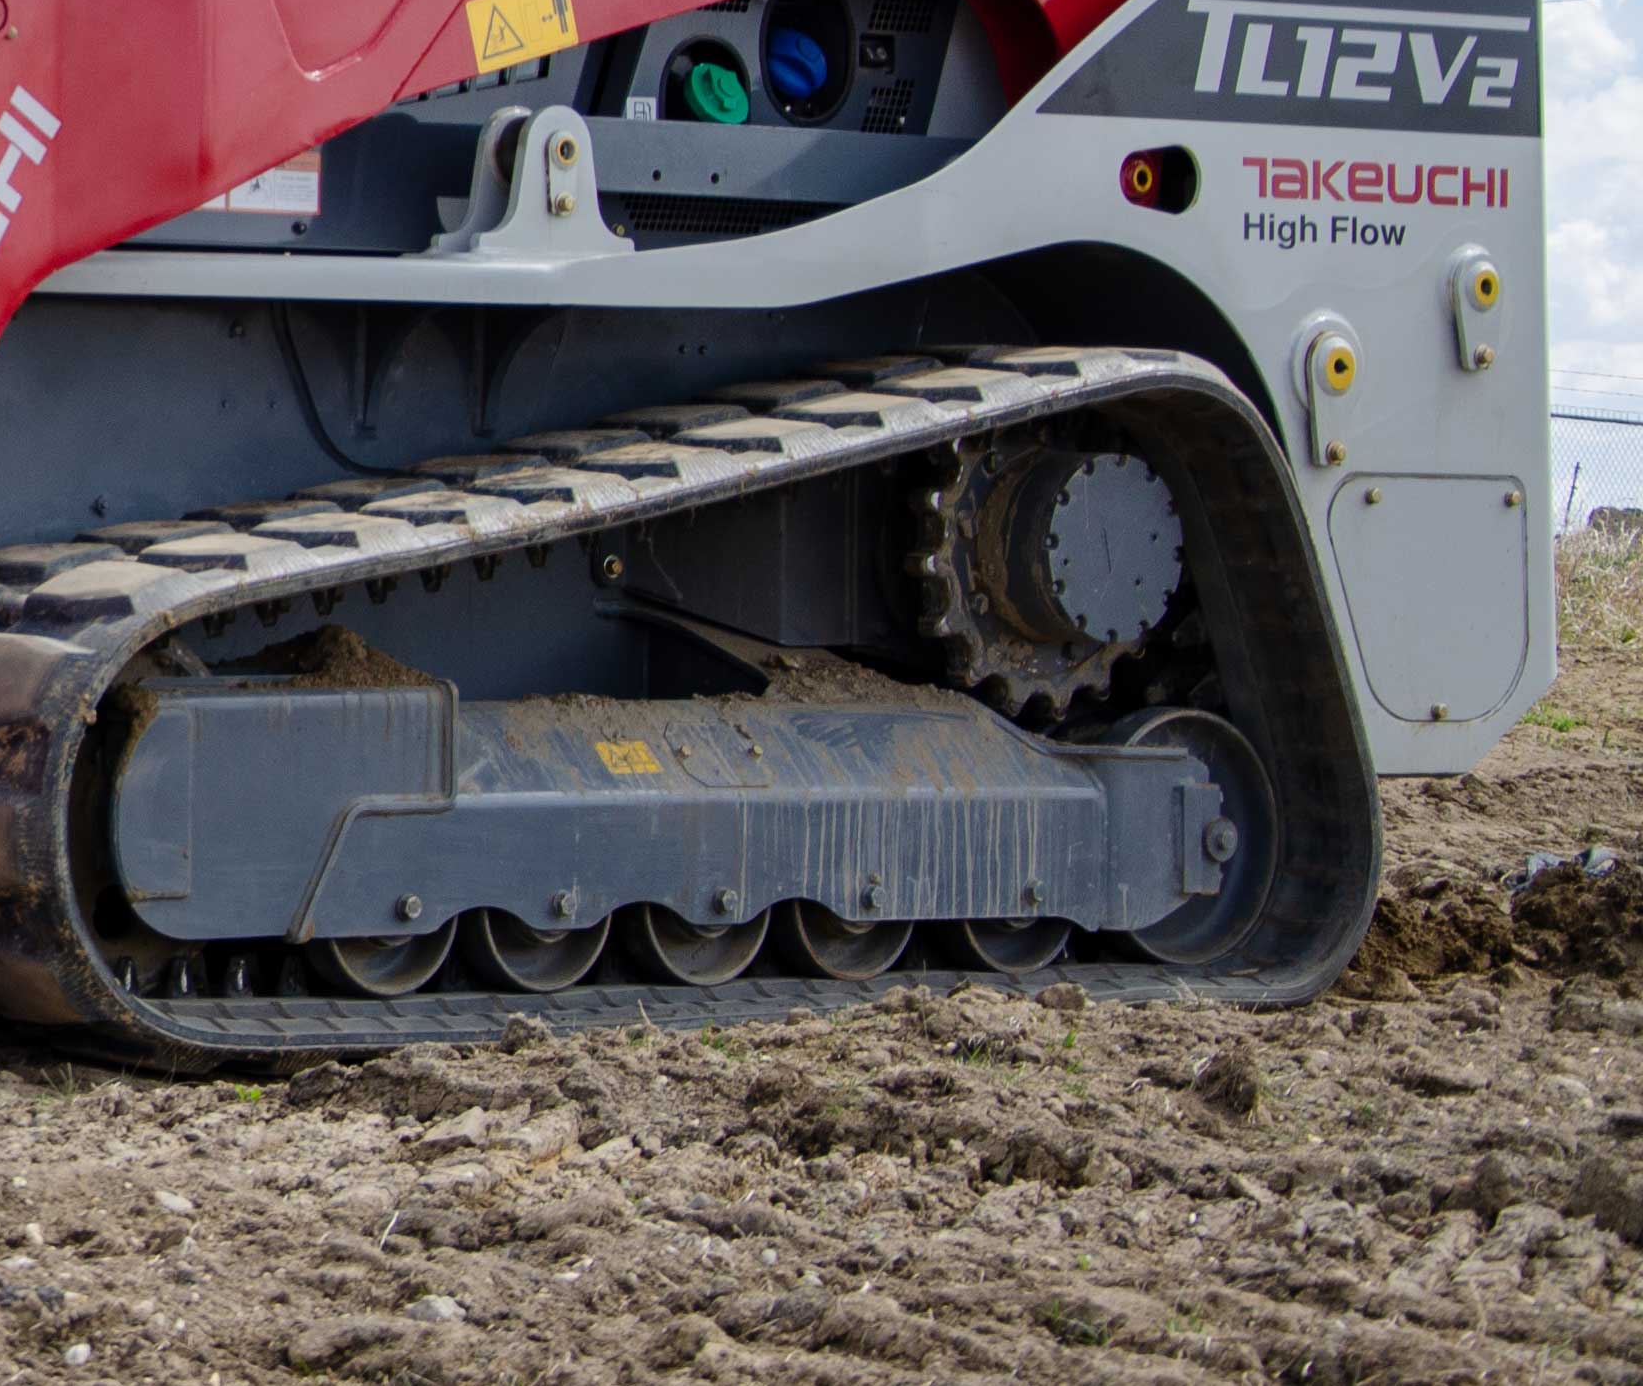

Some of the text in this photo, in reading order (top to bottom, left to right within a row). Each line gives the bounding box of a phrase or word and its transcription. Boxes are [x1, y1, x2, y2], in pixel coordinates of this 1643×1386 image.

[1242, 156, 1509, 209] TAKEUCHI
[1243, 212, 1407, 250] High Flow
